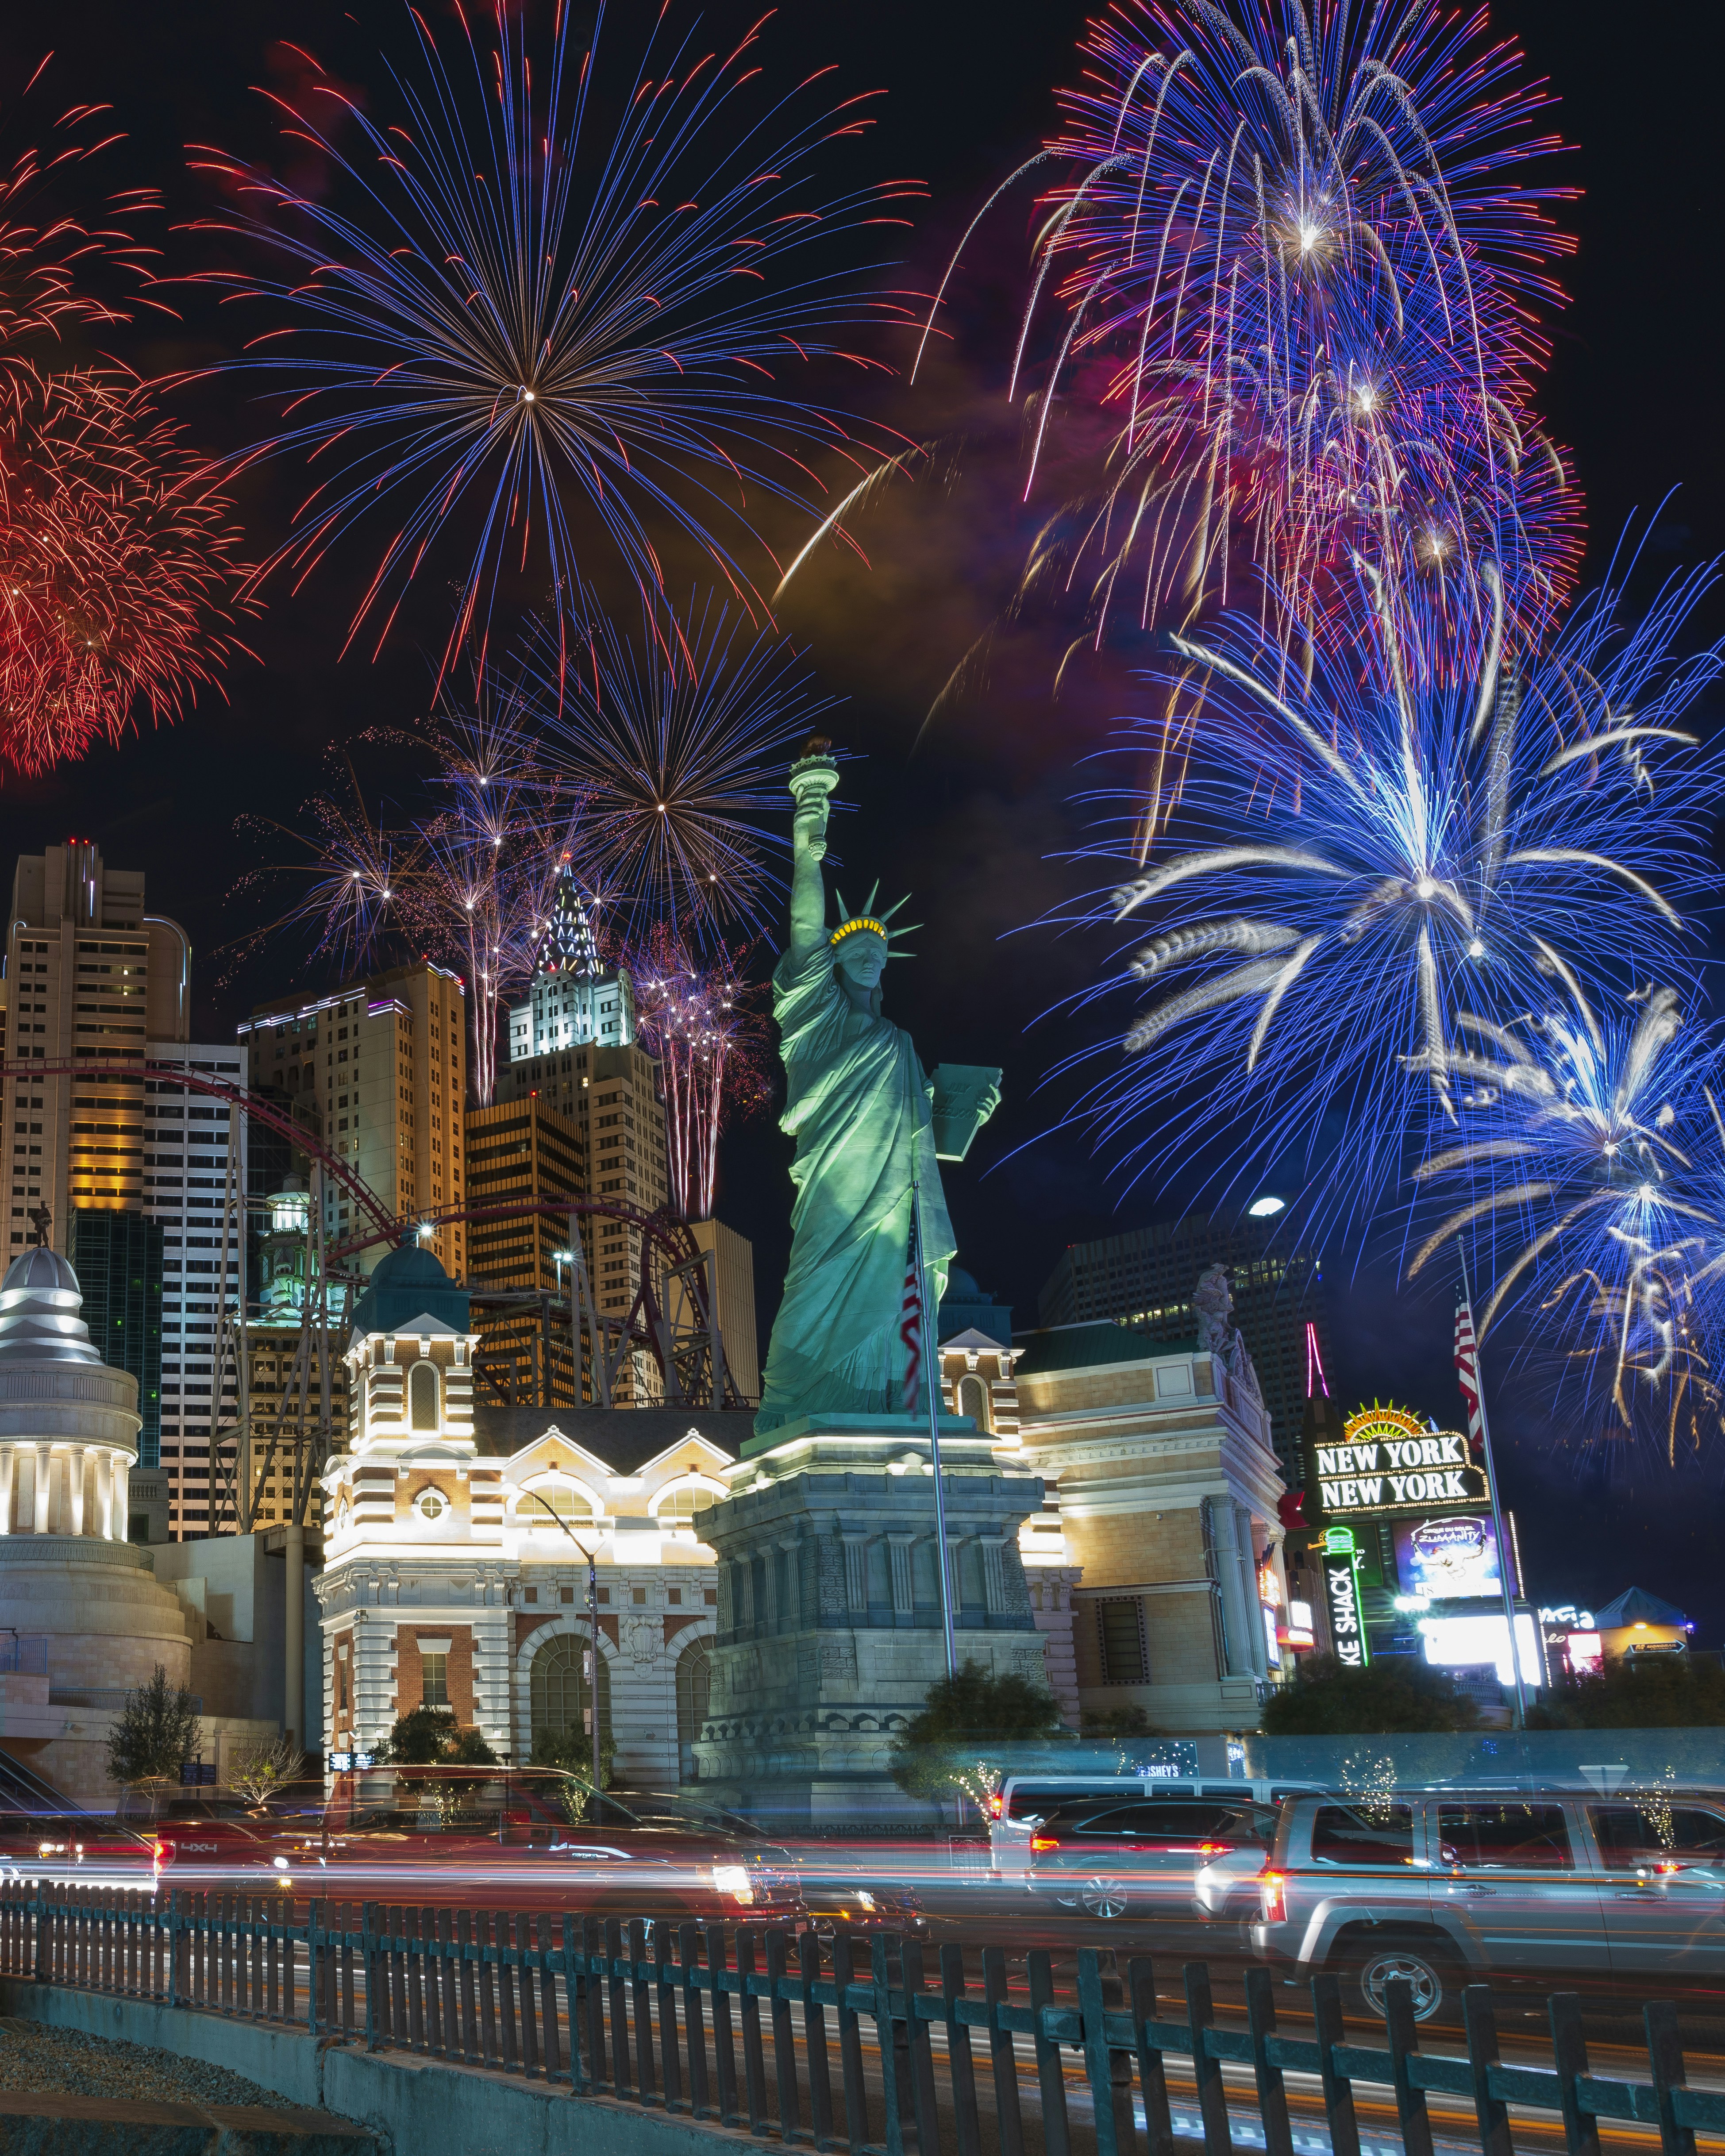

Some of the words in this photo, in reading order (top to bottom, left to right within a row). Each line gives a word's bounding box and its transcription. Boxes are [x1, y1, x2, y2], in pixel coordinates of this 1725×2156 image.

[1317, 1444, 1378, 1475] NEW
[1383, 1436, 1463, 1468] YORK
[1320, 1478, 1382, 1508] NEW
[1387, 1471, 1468, 1502] YORK
[1419, 1531, 1480, 1544] ZUMANITY
[1329, 1567, 1357, 1633] SHACK
